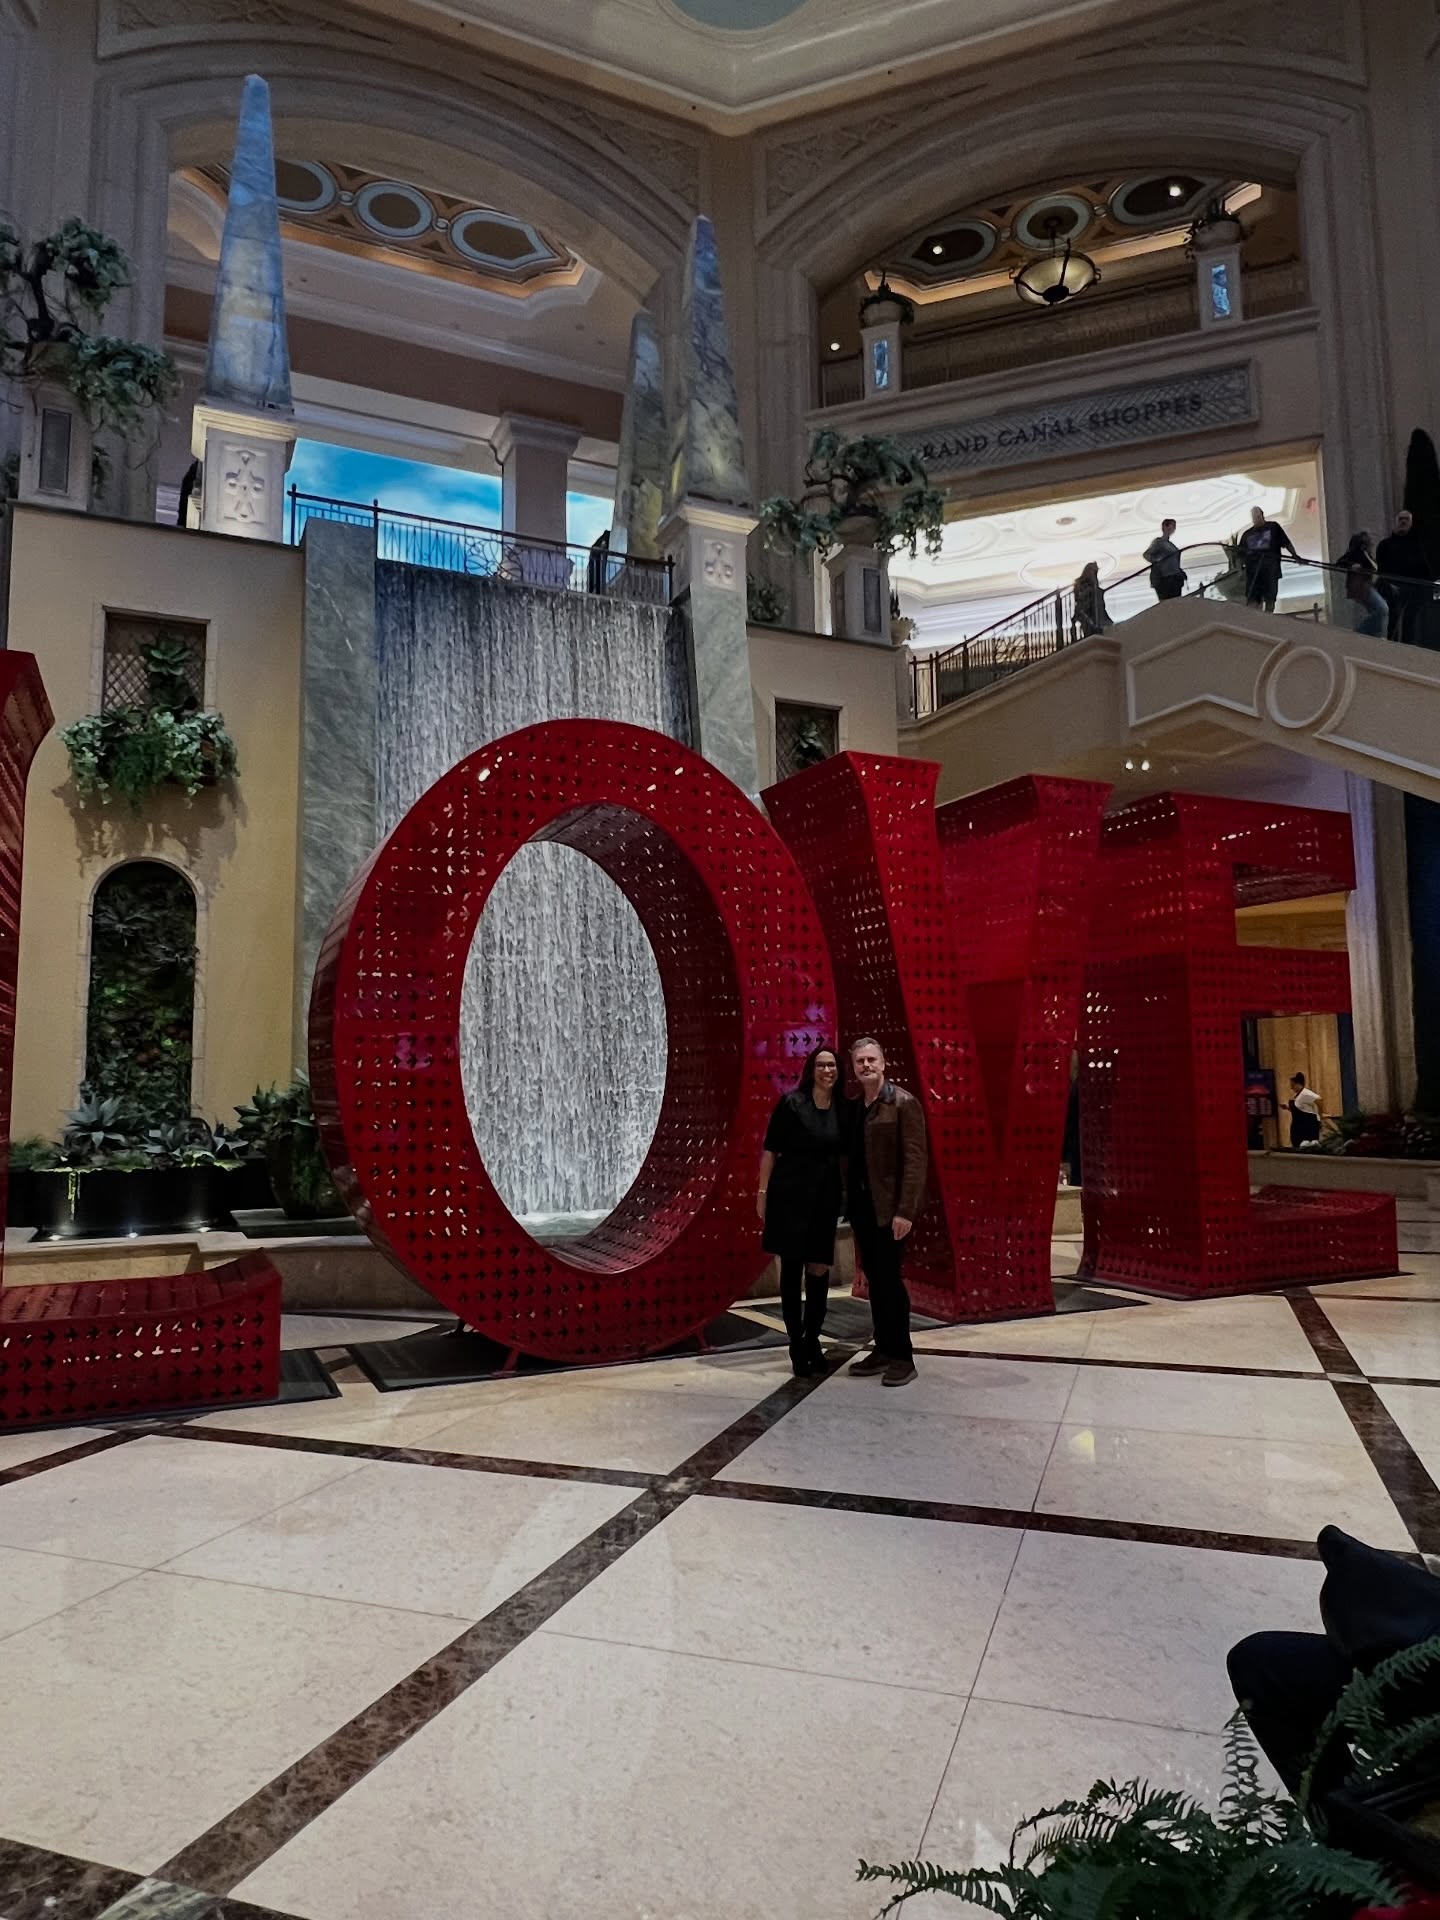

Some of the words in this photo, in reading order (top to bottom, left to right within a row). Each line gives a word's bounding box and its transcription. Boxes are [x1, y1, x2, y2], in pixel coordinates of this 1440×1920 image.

[917, 434, 989, 459] RAND
[997, 416, 1080, 447] CANAL
[1089, 393, 1202, 430] SHOPPES
